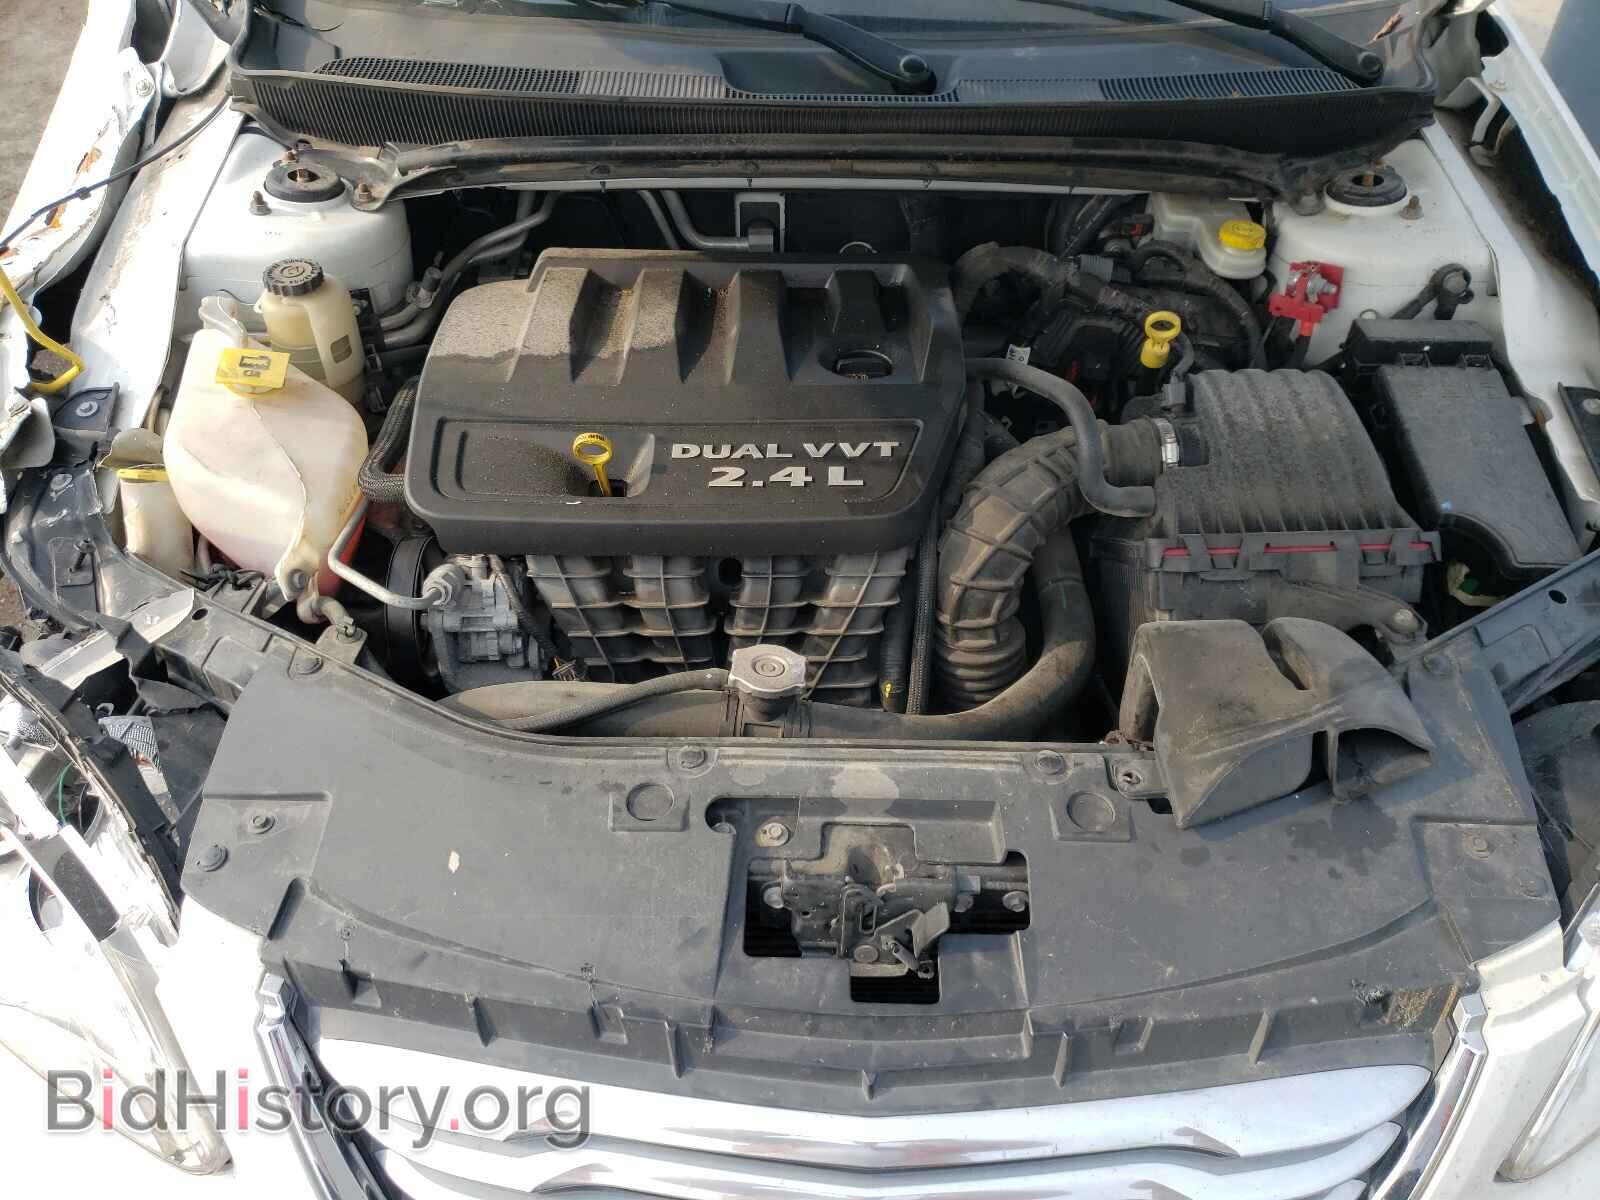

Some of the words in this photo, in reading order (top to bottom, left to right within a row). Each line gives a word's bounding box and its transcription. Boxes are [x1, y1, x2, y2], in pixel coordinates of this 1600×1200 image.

[671, 443, 793, 459] DUAL
[802, 442, 899, 458] VVT
[708, 466, 813, 487] 2.4
[828, 466, 864, 486] L
